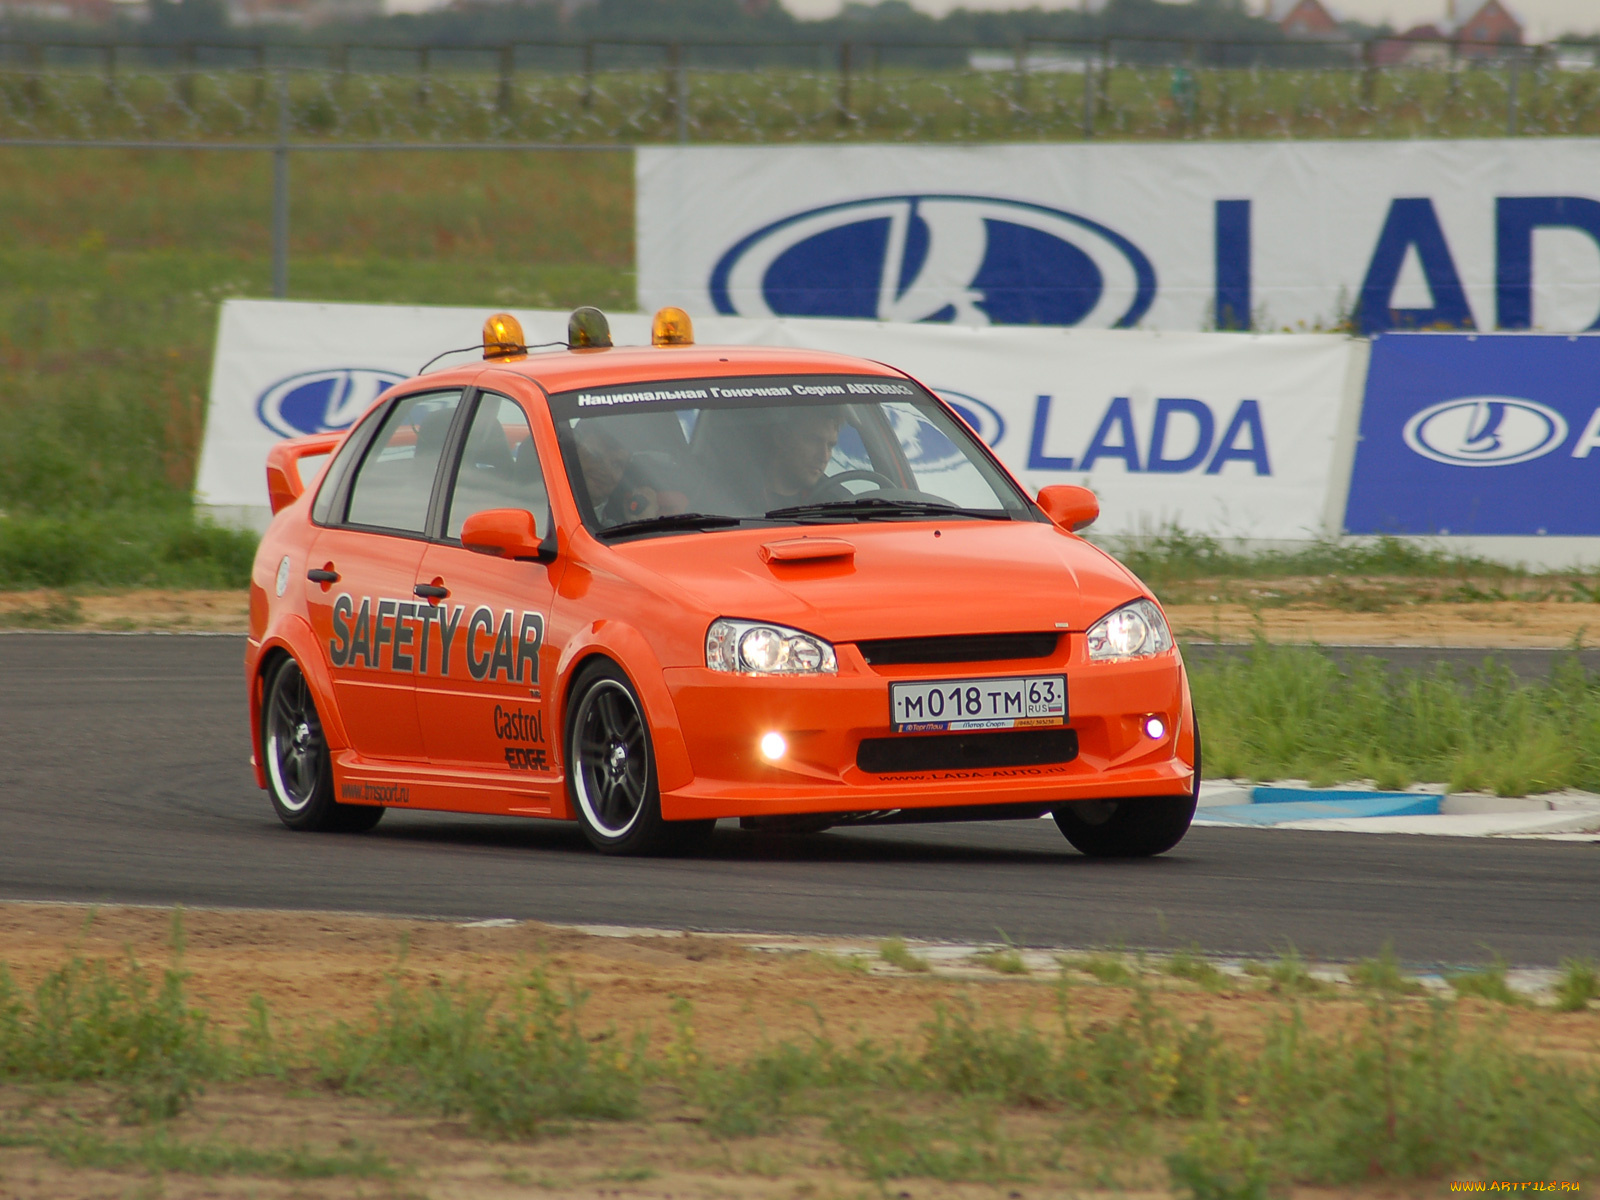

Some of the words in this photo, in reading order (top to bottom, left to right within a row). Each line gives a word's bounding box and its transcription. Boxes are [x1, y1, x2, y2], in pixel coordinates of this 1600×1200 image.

[578, 389, 707, 407] Национальная
[710, 386, 792, 398] Гоночная
[793, 384, 845, 397] Серия
[846, 383, 914, 396] АВТОВАЗ
[1026, 395, 1272, 476] LADA
[330, 592, 465, 677] SAFETY
[466, 604, 545, 686] CAR
[1028, 681, 1055, 704] 63
[1028, 703, 1048, 713] RUS
[494, 704, 545, 743] Castrol
[505, 747, 550, 771] EDGE
[879, 767, 1066, 781] www.LADA-AUTO.ru
